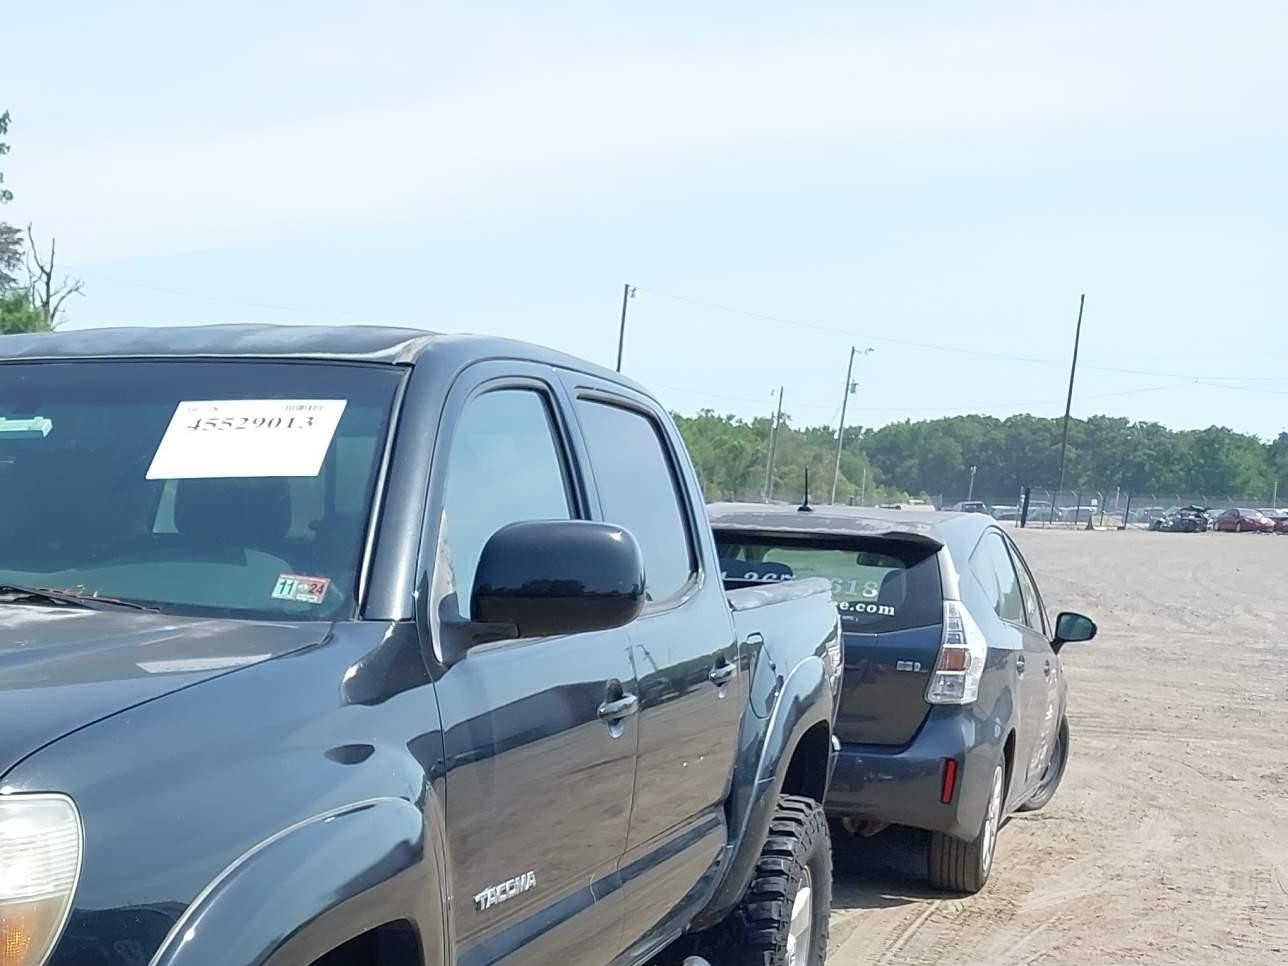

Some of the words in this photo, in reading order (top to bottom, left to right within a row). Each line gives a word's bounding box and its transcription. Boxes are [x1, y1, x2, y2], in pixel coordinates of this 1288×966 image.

[186, 415, 315, 431] 45529013
[278, 579, 295, 596] 11
[308, 582, 325, 596] 24
[833, 600, 896, 617] e.com
[473, 870, 536, 912] TACOMA
